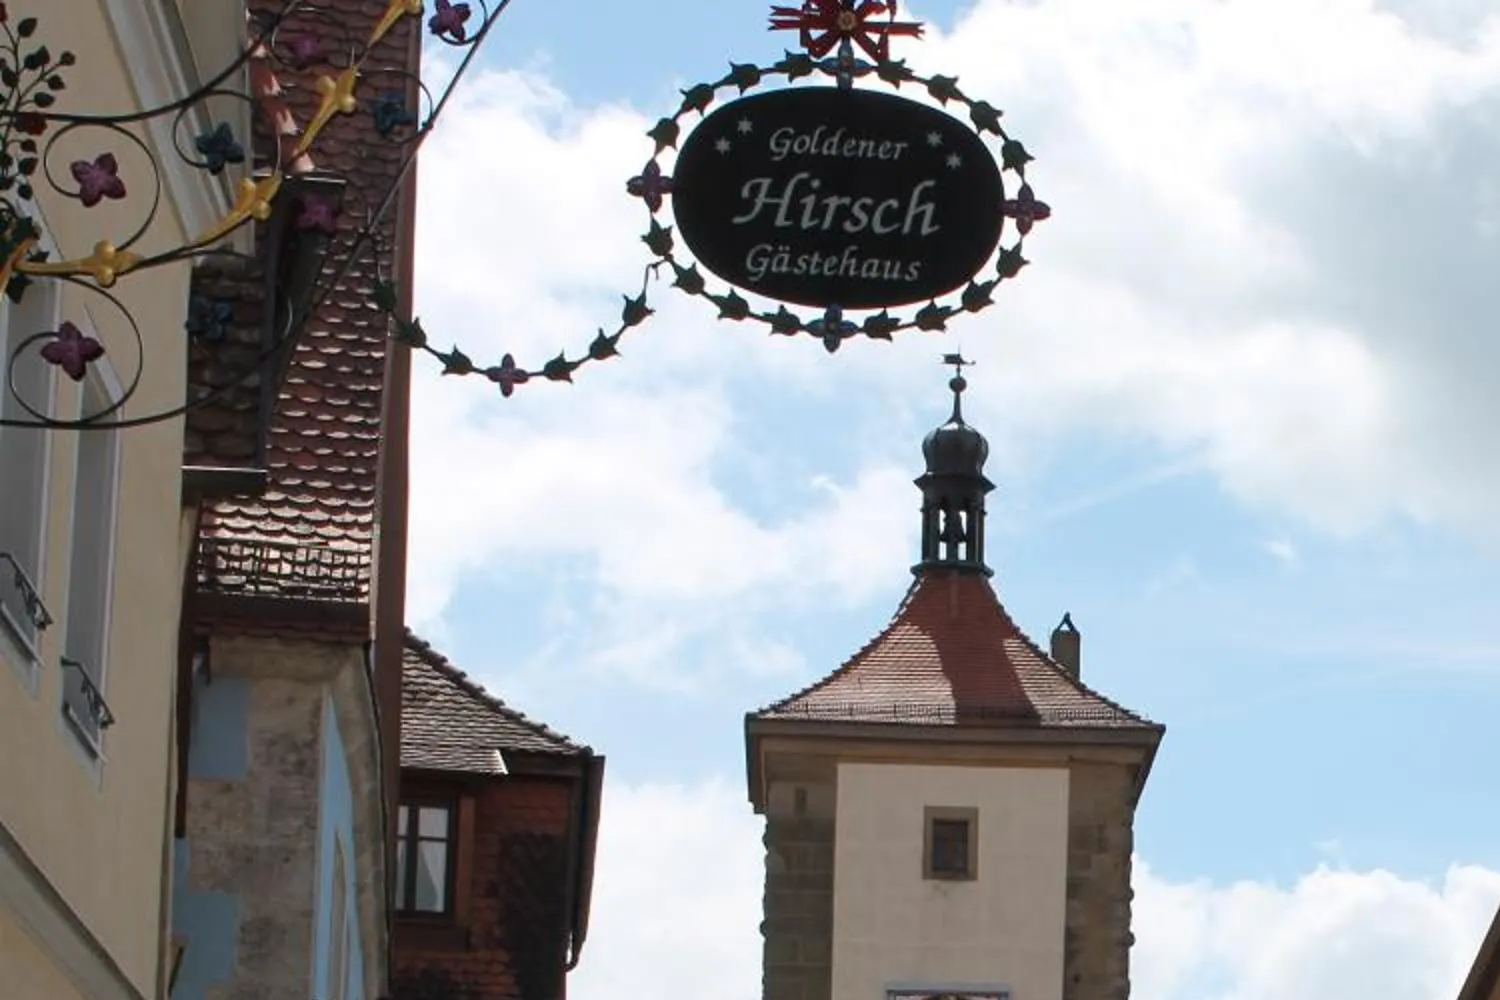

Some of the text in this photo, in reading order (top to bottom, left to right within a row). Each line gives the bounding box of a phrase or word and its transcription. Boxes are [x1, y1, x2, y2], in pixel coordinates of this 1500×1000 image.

[769, 126, 908, 161] Goldener
[732, 172, 940, 236] Hirsch
[745, 243, 921, 281] Gästehaus
